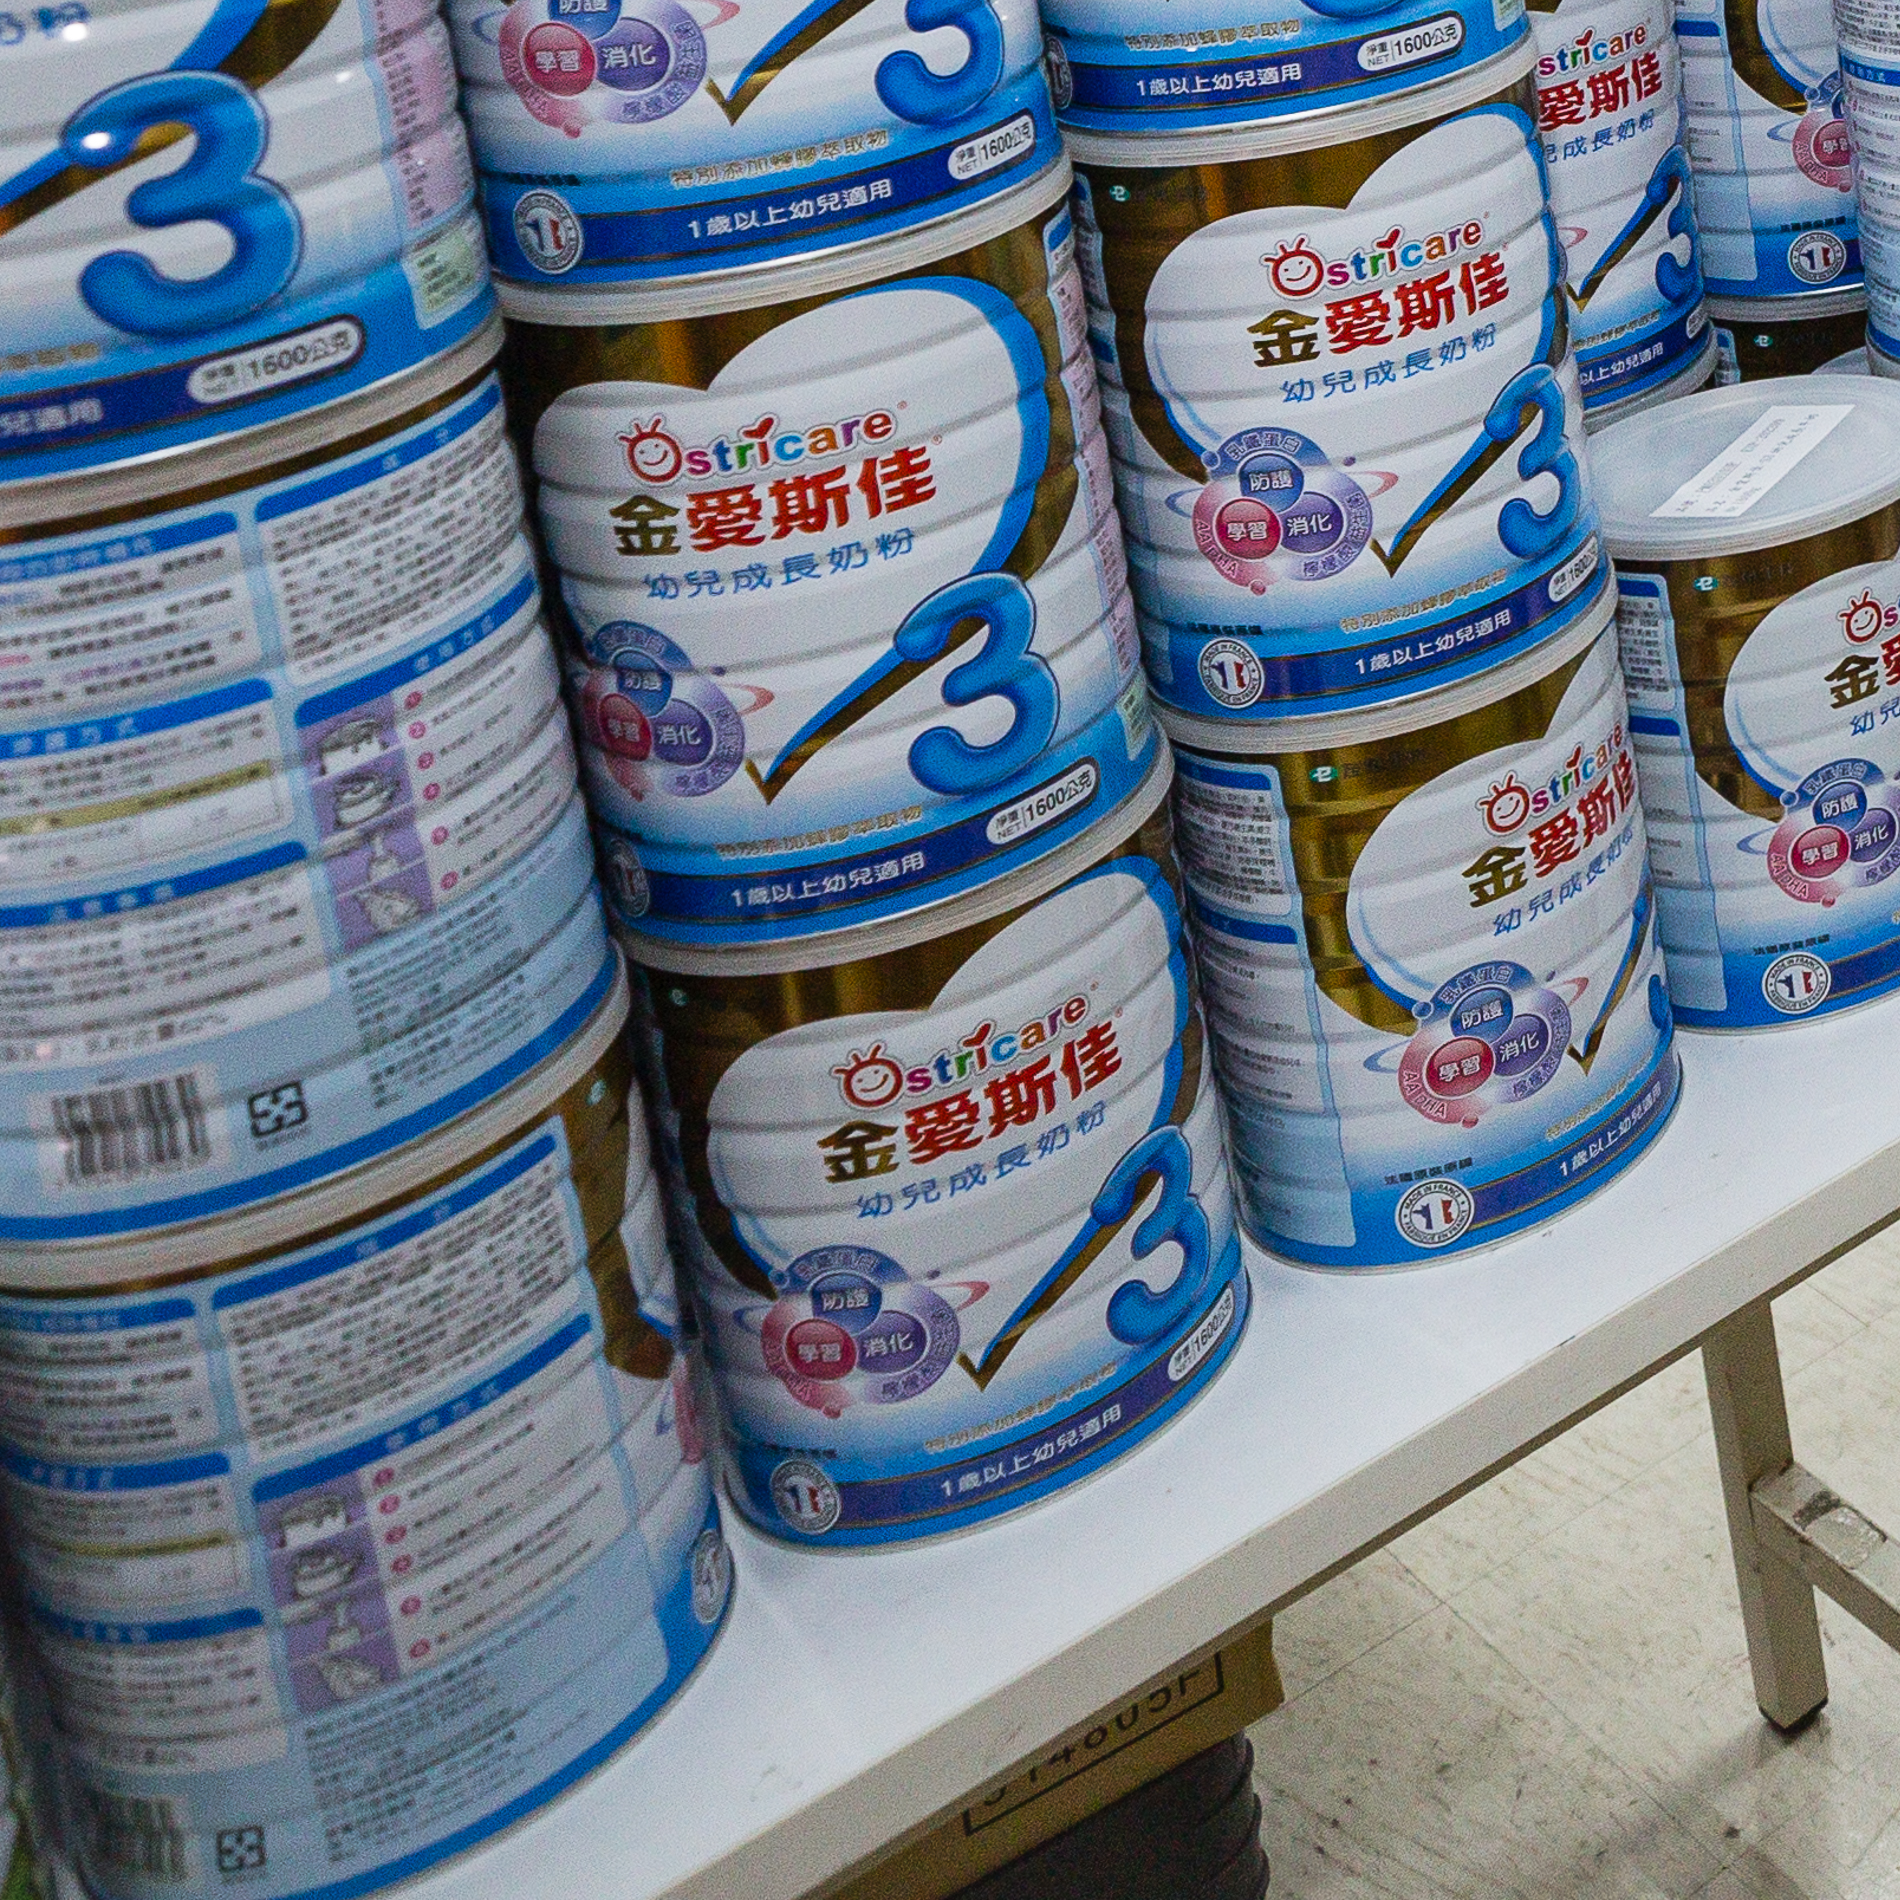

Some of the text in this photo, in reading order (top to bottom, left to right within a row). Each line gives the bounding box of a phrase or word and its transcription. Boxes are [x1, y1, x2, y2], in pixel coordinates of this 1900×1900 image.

[534, 47, 580, 70] 學習
[602, 44, 656, 67] 消化
[1136, 63, 1302, 97] 1歲以上幼兒適用
[1367, 51, 1390, 66] NET
[62, 69, 304, 339] 3
[688, 178, 891, 241] 1歲以上幼兒適用
[1261, 218, 1483, 297] Ostricare
[1247, 251, 1510, 369] 金愛斯佳
[1280, 322, 1497, 405] 幼兒成長奶粉
[618, 410, 894, 487] Ostricare
[1248, 469, 1293, 491] 防護
[1484, 363, 1579, 561] 3
[610, 445, 937, 558] 金愛斯佳
[1226, 518, 1269, 541] 學習
[1287, 516, 1332, 537] 消化
[643, 527, 915, 601] 幼兒成長奶粉
[1354, 610, 1512, 676] 1歲以上幼兒適用
[893, 571, 1061, 798] 3
[1462, 749, 1636, 910] 金愛斯佳
[1855, 824, 1890, 850] 消化
[1461, 1002, 1504, 1028] 防護
[1500, 1031, 1539, 1062] 消化
[831, 996, 1087, 1109] Ostricare
[1438, 1055, 1481, 1080] 學習
[817, 1028, 1124, 1184] 金愛斯佳
[856, 1101, 1107, 1218] 幼兒成長奶粉
[1090, 1125, 1210, 1345] 3
[863, 1335, 912, 1358] 消化
[941, 1404, 1122, 1497] 1歲以上幼兒適用
